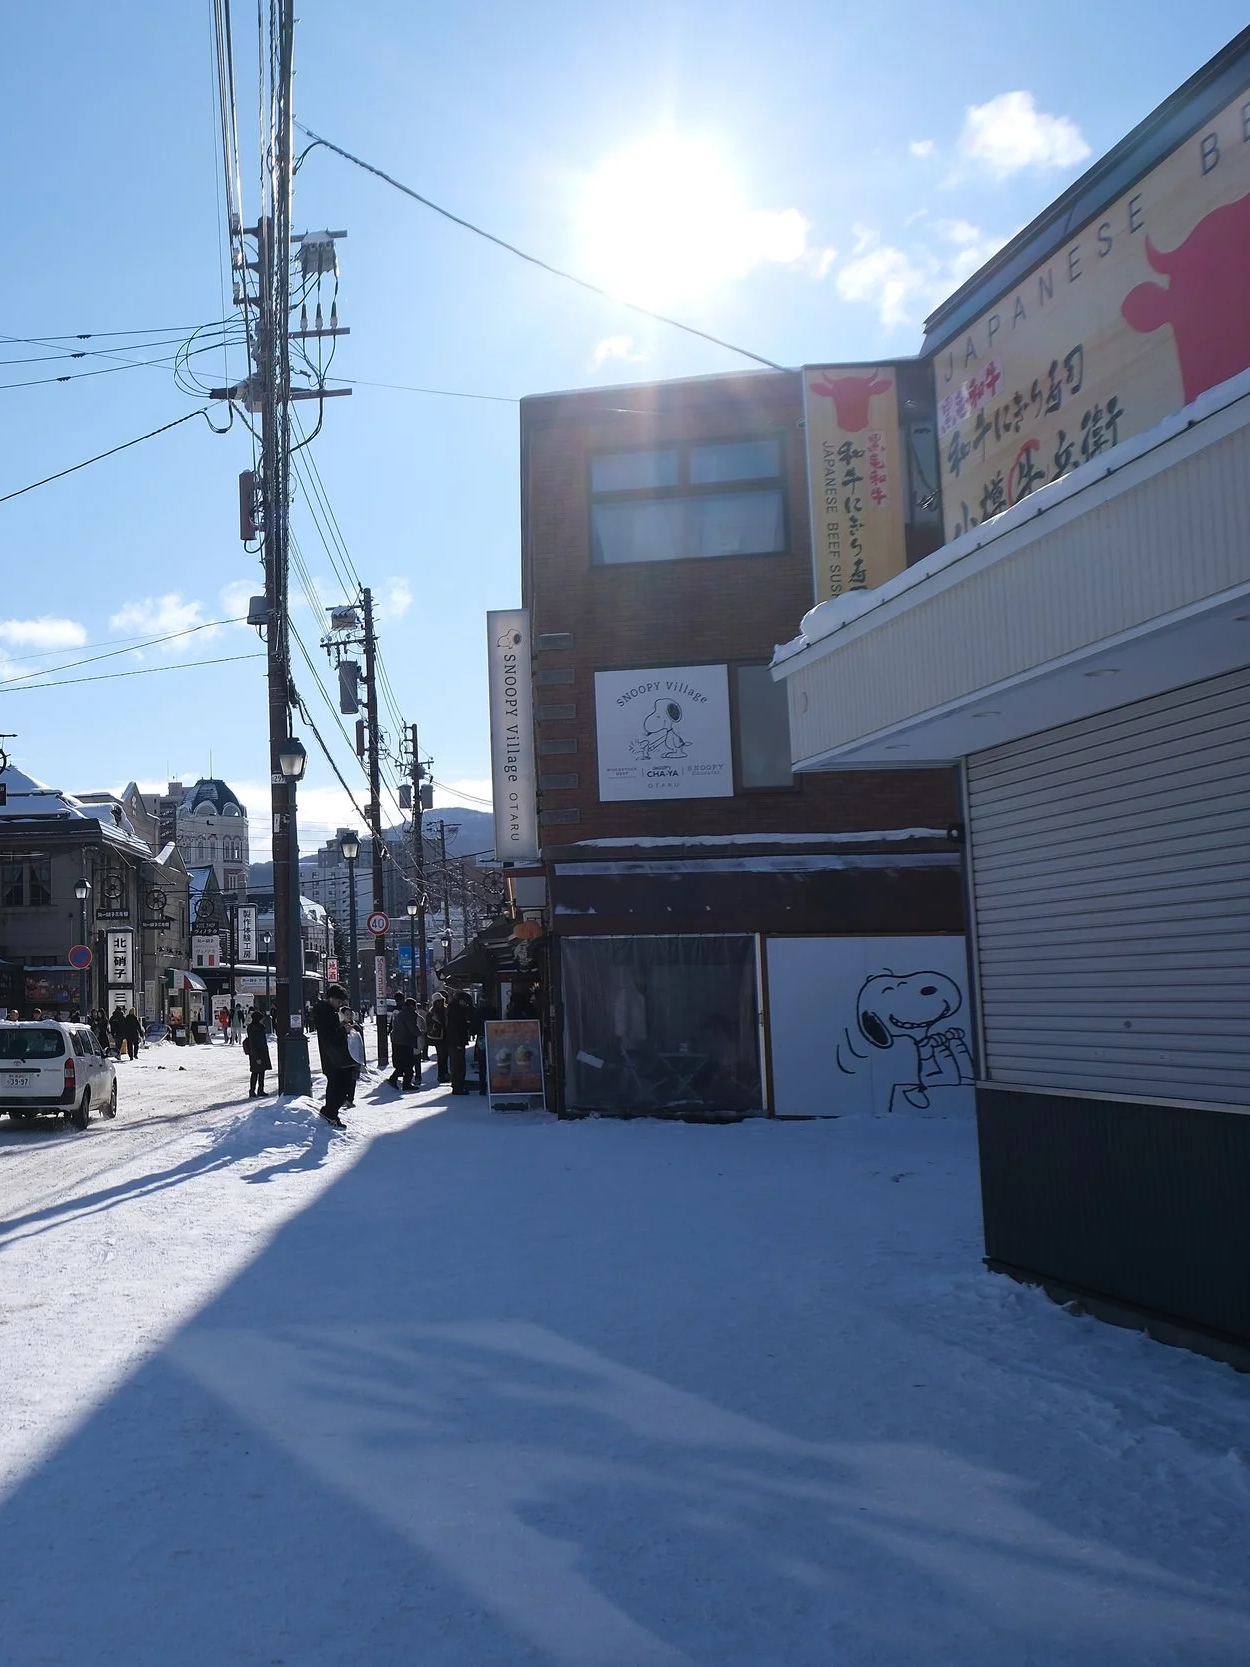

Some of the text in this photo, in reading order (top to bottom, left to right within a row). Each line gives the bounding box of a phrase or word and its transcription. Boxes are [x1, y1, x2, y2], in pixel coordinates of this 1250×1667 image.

[945, 193, 1145, 382] JAPANESE
[823, 441, 838, 514] JAPANESE
[827, 522, 841, 558] BEEF
[617, 680, 708, 707] SNOOPY Village
[504, 654, 520, 842] SNOOPY Village OTARU
[647, 770, 679, 778] CHA-YA
[372, 918, 385, 928] 40
[114, 937, 127, 979] 北一硝子
[328, 961, 338, 980] 地酒
